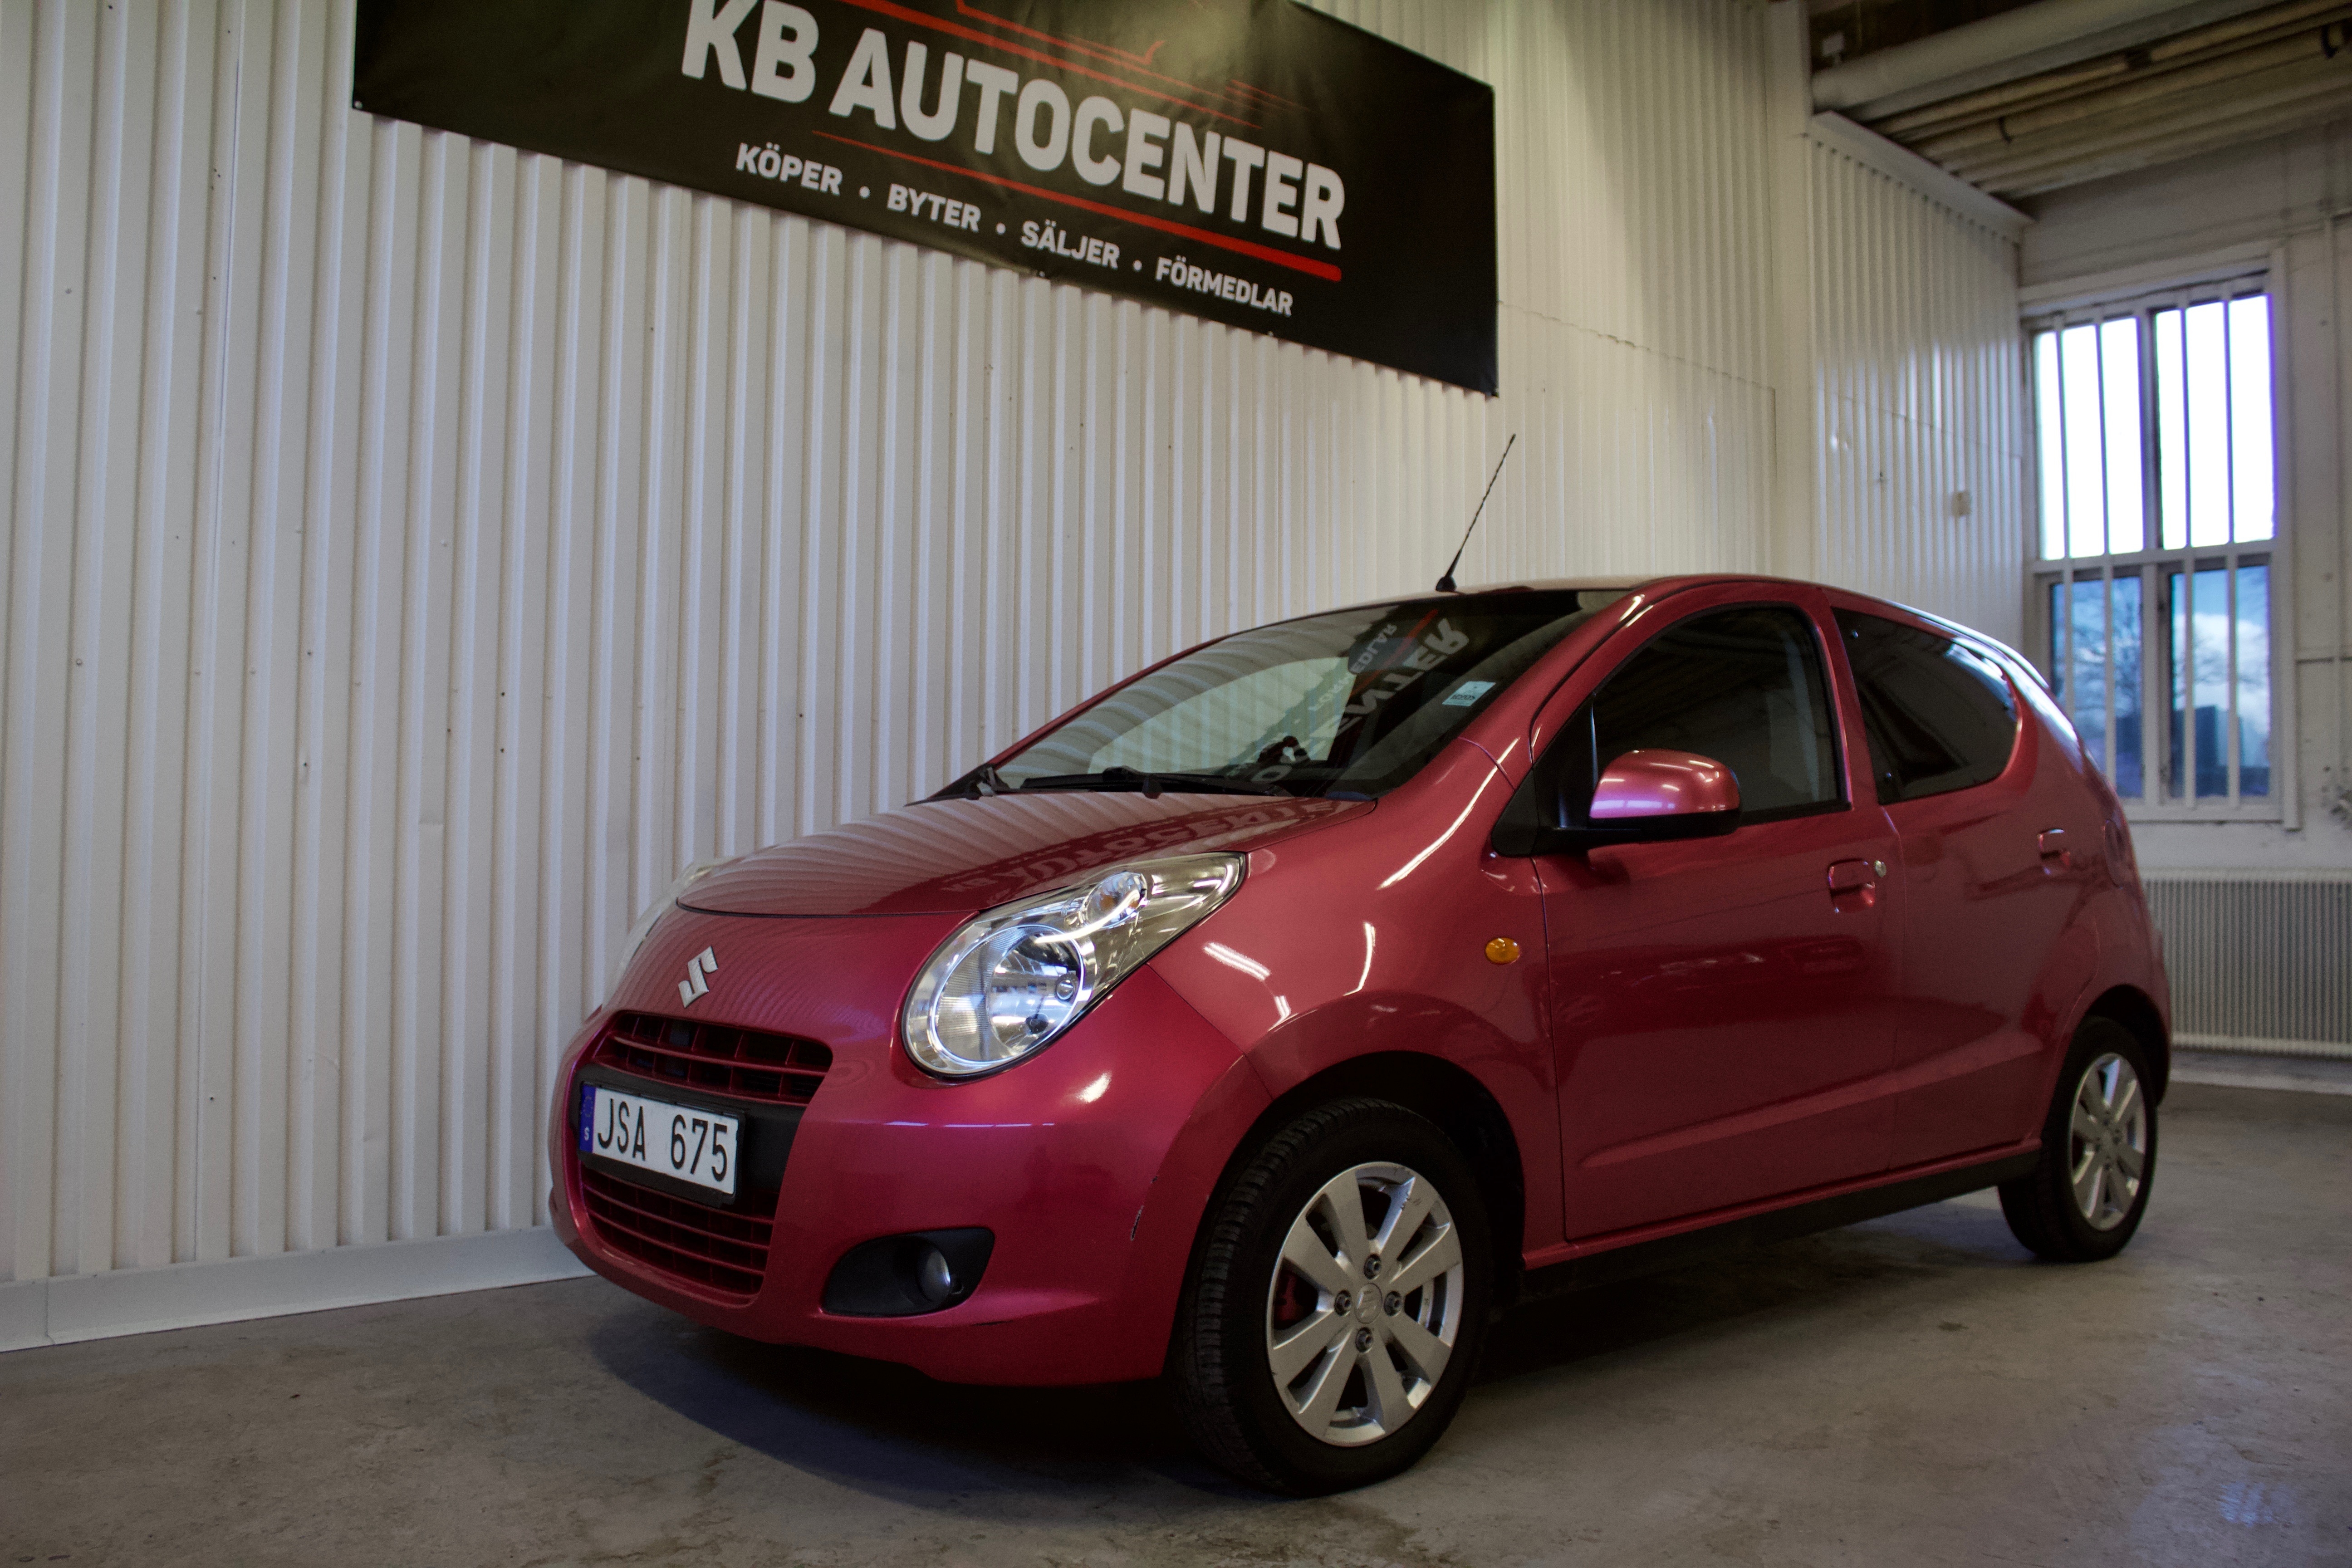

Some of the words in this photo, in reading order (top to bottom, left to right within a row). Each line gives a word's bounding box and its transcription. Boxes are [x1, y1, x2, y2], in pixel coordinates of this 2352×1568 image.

[681, 0, 819, 103] KB
[829, 28, 1345, 249] AUTOCENTER
[735, 142, 843, 196] KÖPER
[887, 183, 981, 232] BYTER
[1020, 219, 1120, 269] SÄLJER
[1156, 255, 1294, 316] FÖRMEDLAR
[584, 1127, 590, 1141] S
[598, 1098, 646, 1161] JSA
[671, 1114, 728, 1182] 675
